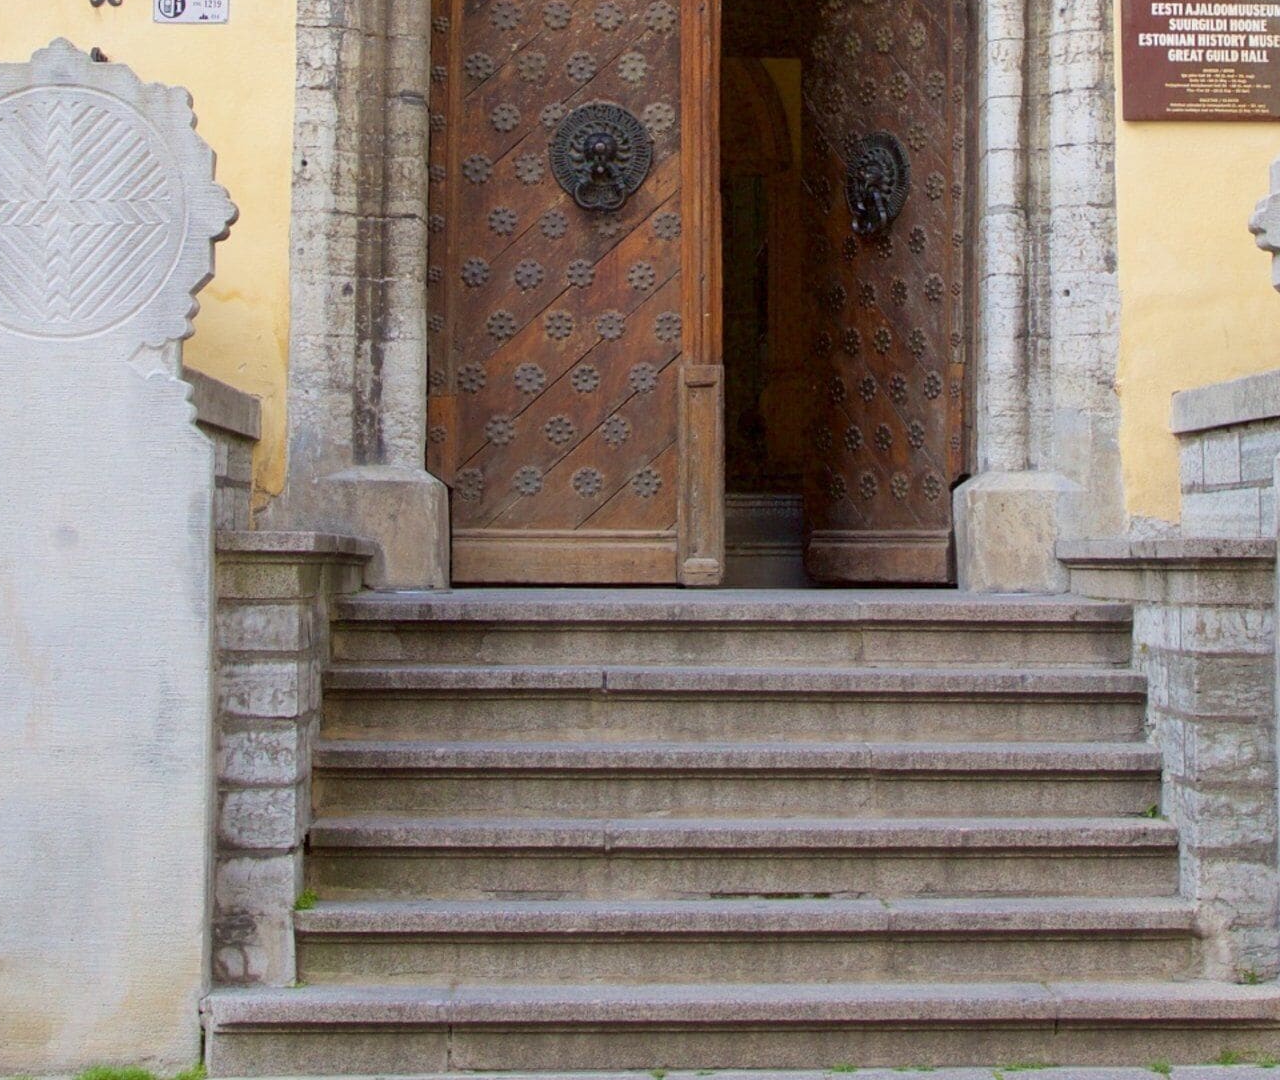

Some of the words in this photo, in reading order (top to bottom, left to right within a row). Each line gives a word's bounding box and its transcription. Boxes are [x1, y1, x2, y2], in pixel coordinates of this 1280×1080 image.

[1151, 3, 1182, 15] EESTI
[1169, 18, 1227, 31] SUURGILDI
[1230, 19, 1267, 32] HOONE
[1138, 33, 1195, 46] ESTONIAN
[1198, 34, 1246, 47] HISTORY
[1168, 49, 1204, 62] GREAT
[1206, 50, 1239, 62] GUILD
[1241, 50, 1269, 63] HALL
